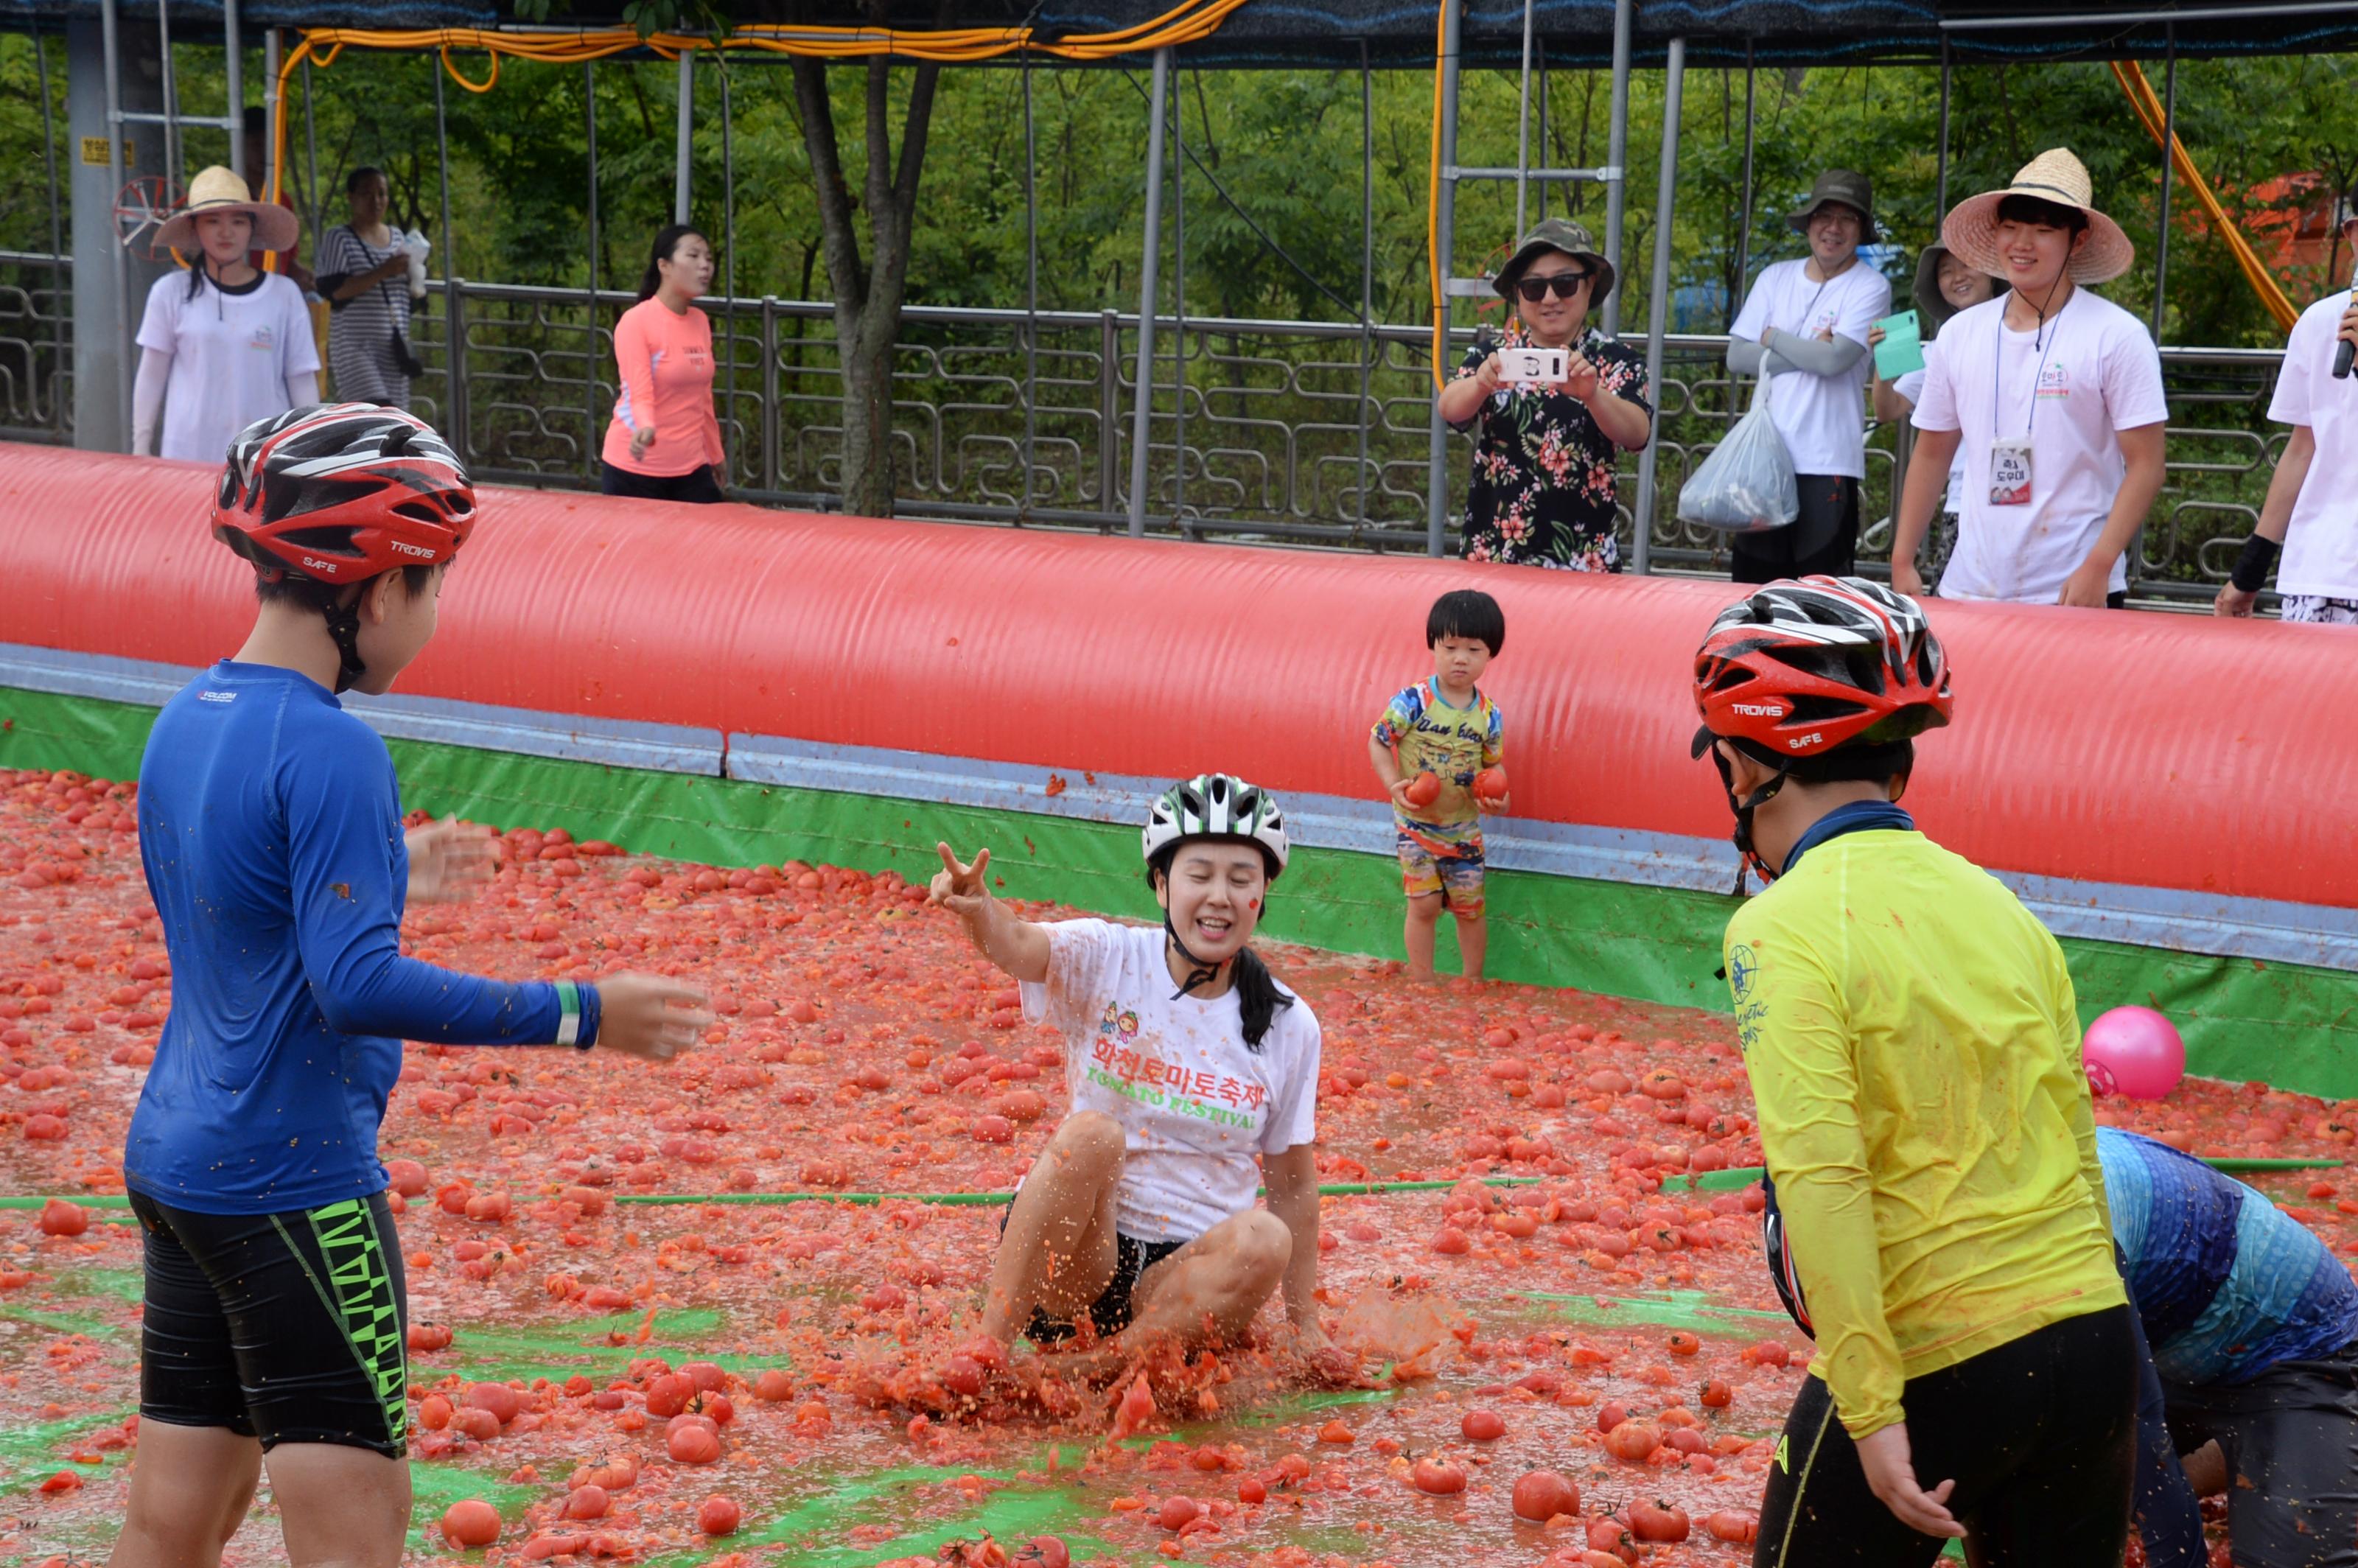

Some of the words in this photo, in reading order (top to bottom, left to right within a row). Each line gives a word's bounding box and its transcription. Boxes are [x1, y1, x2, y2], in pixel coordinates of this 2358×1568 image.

[391, 540, 436, 559] TROVIS
[303, 556, 337, 573] SAFE
[1732, 704, 1783, 717] TROVIS
[1789, 732, 1822, 749] SAFE
[1092, 1037, 1265, 1112] 화천토마토축제
[1087, 1066, 1165, 1105] TOMATO
